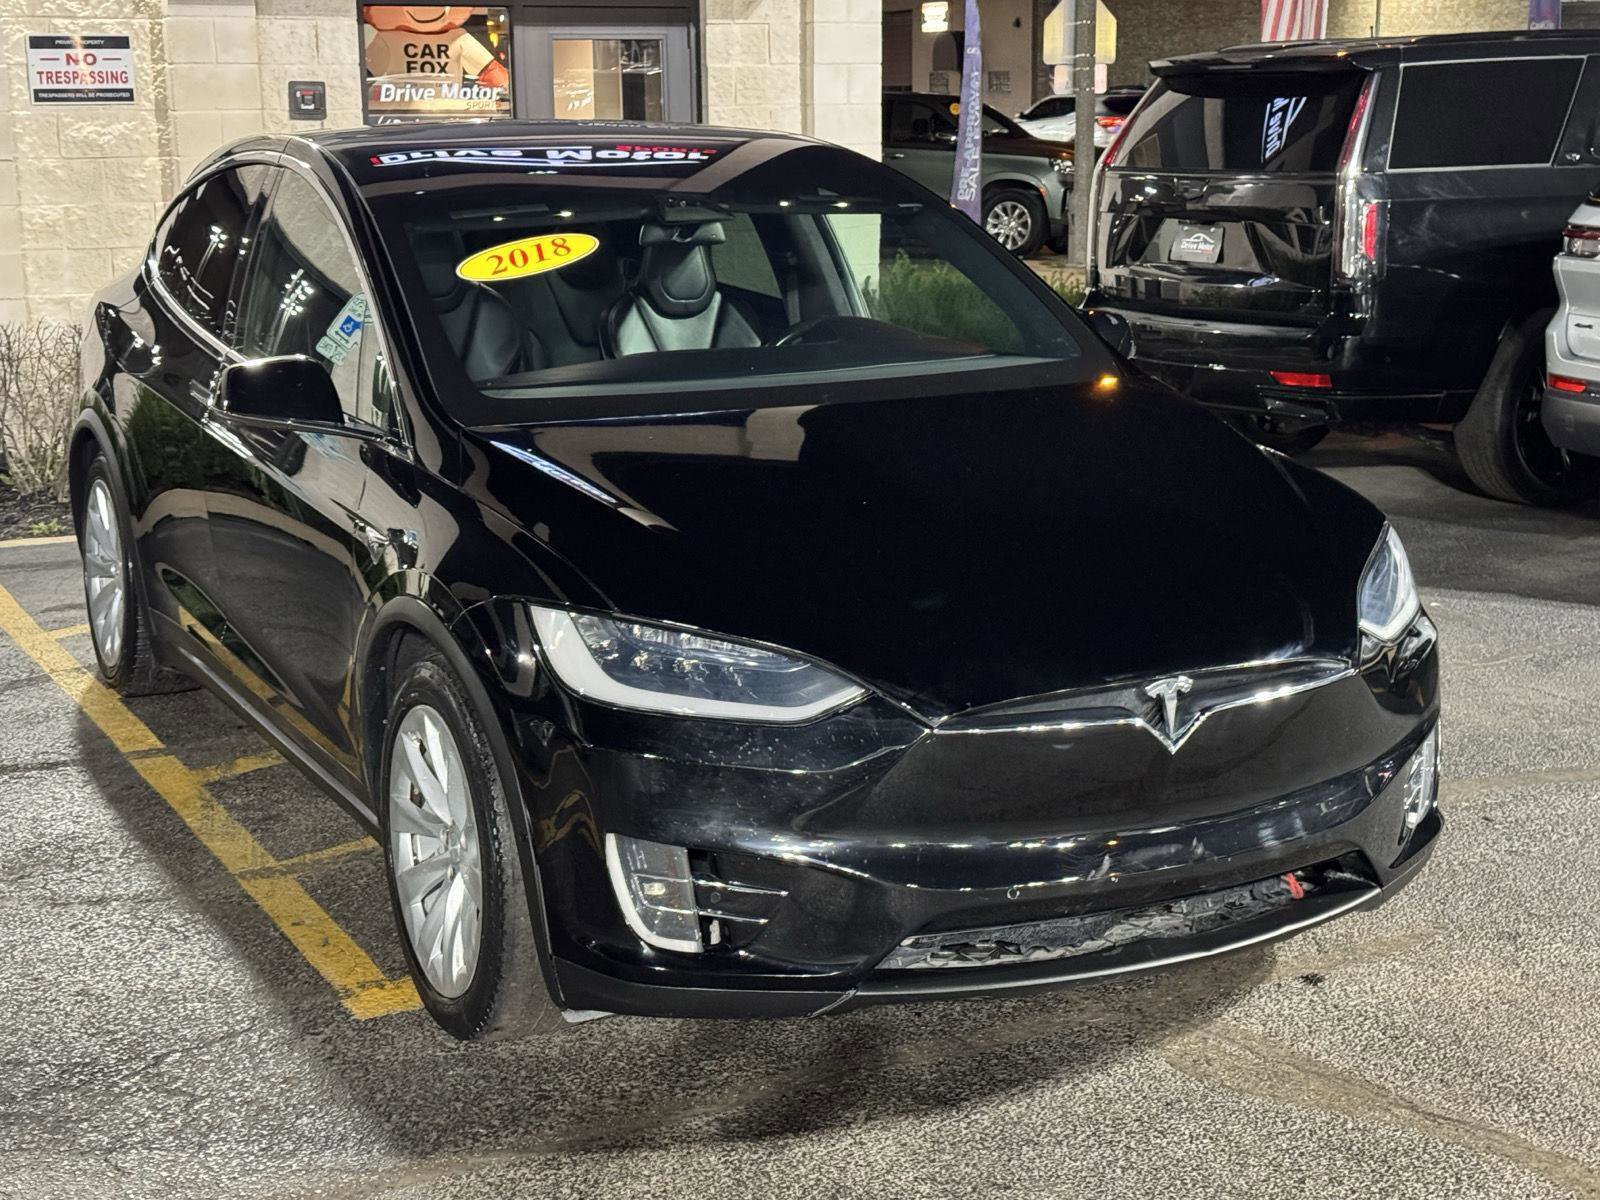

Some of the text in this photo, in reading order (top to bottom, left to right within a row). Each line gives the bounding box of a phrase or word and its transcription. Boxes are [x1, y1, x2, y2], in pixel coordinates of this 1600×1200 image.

[403, 42, 450, 59] CAR
[65, 52, 98, 66] NO
[406, 60, 449, 74] FOX
[36, 70, 130, 85] TRESPASSING
[440, 82, 502, 101] Motor
[465, 100, 501, 110] SPORTS
[486, 236, 572, 276] 2018
